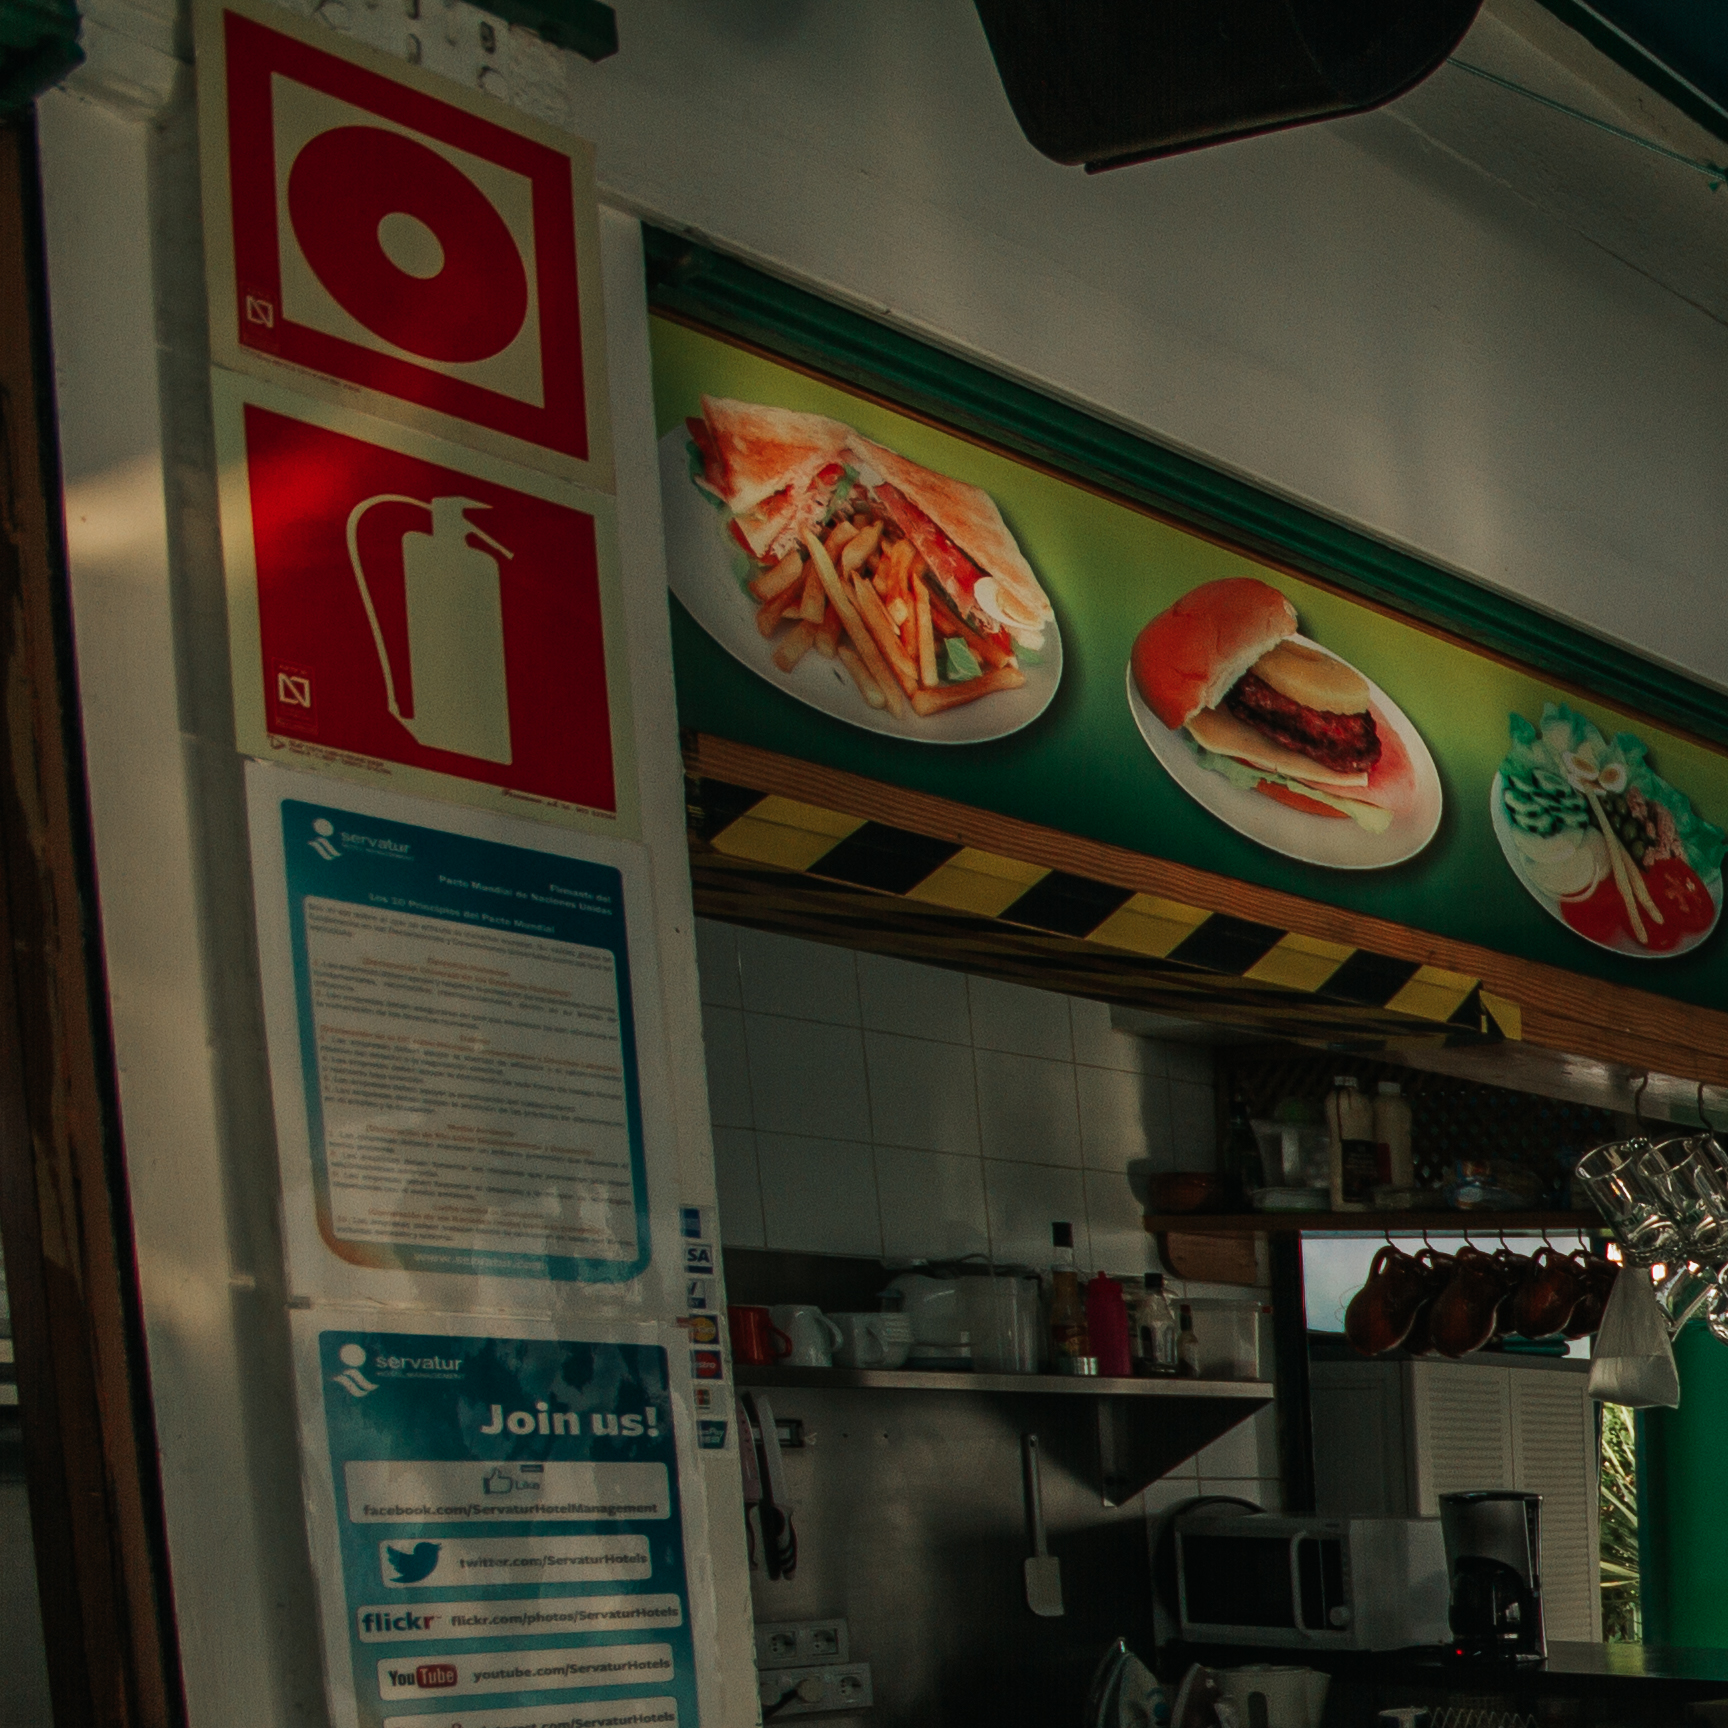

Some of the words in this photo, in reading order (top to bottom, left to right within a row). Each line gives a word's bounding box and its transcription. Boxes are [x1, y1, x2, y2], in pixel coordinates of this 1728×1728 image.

[341, 829, 412, 855] servatur
[438, 874, 469, 889] Pacto
[470, 880, 514, 898] Mundial
[515, 889, 528, 900] de
[530, 892, 577, 909] Naciones
[578, 901, 613, 916] Unidas
[596, 892, 612, 904] del
[368, 893, 389, 904] Los
[391, 896, 406, 907] 10
[408, 899, 461, 918] Principios
[463, 909, 480, 921] del
[481, 912, 511, 927] Pacto
[513, 918, 556, 934] Mundial
[374, 1354, 464, 1372] servatur
[480, 1400, 580, 1436] Join
[591, 1406, 660, 1438] us!
[362, 1502, 658, 1519] facebook.com/ServaturHotelManagement
[458, 1553, 648, 1570] twitter.com/ServaturHotels
[361, 1611, 434, 1633] flickr
[449, 1606, 680, 1629] flickr.com/photos/ServaturHotels
[472, 1656, 672, 1684] youtube.com/ServaturHotels
